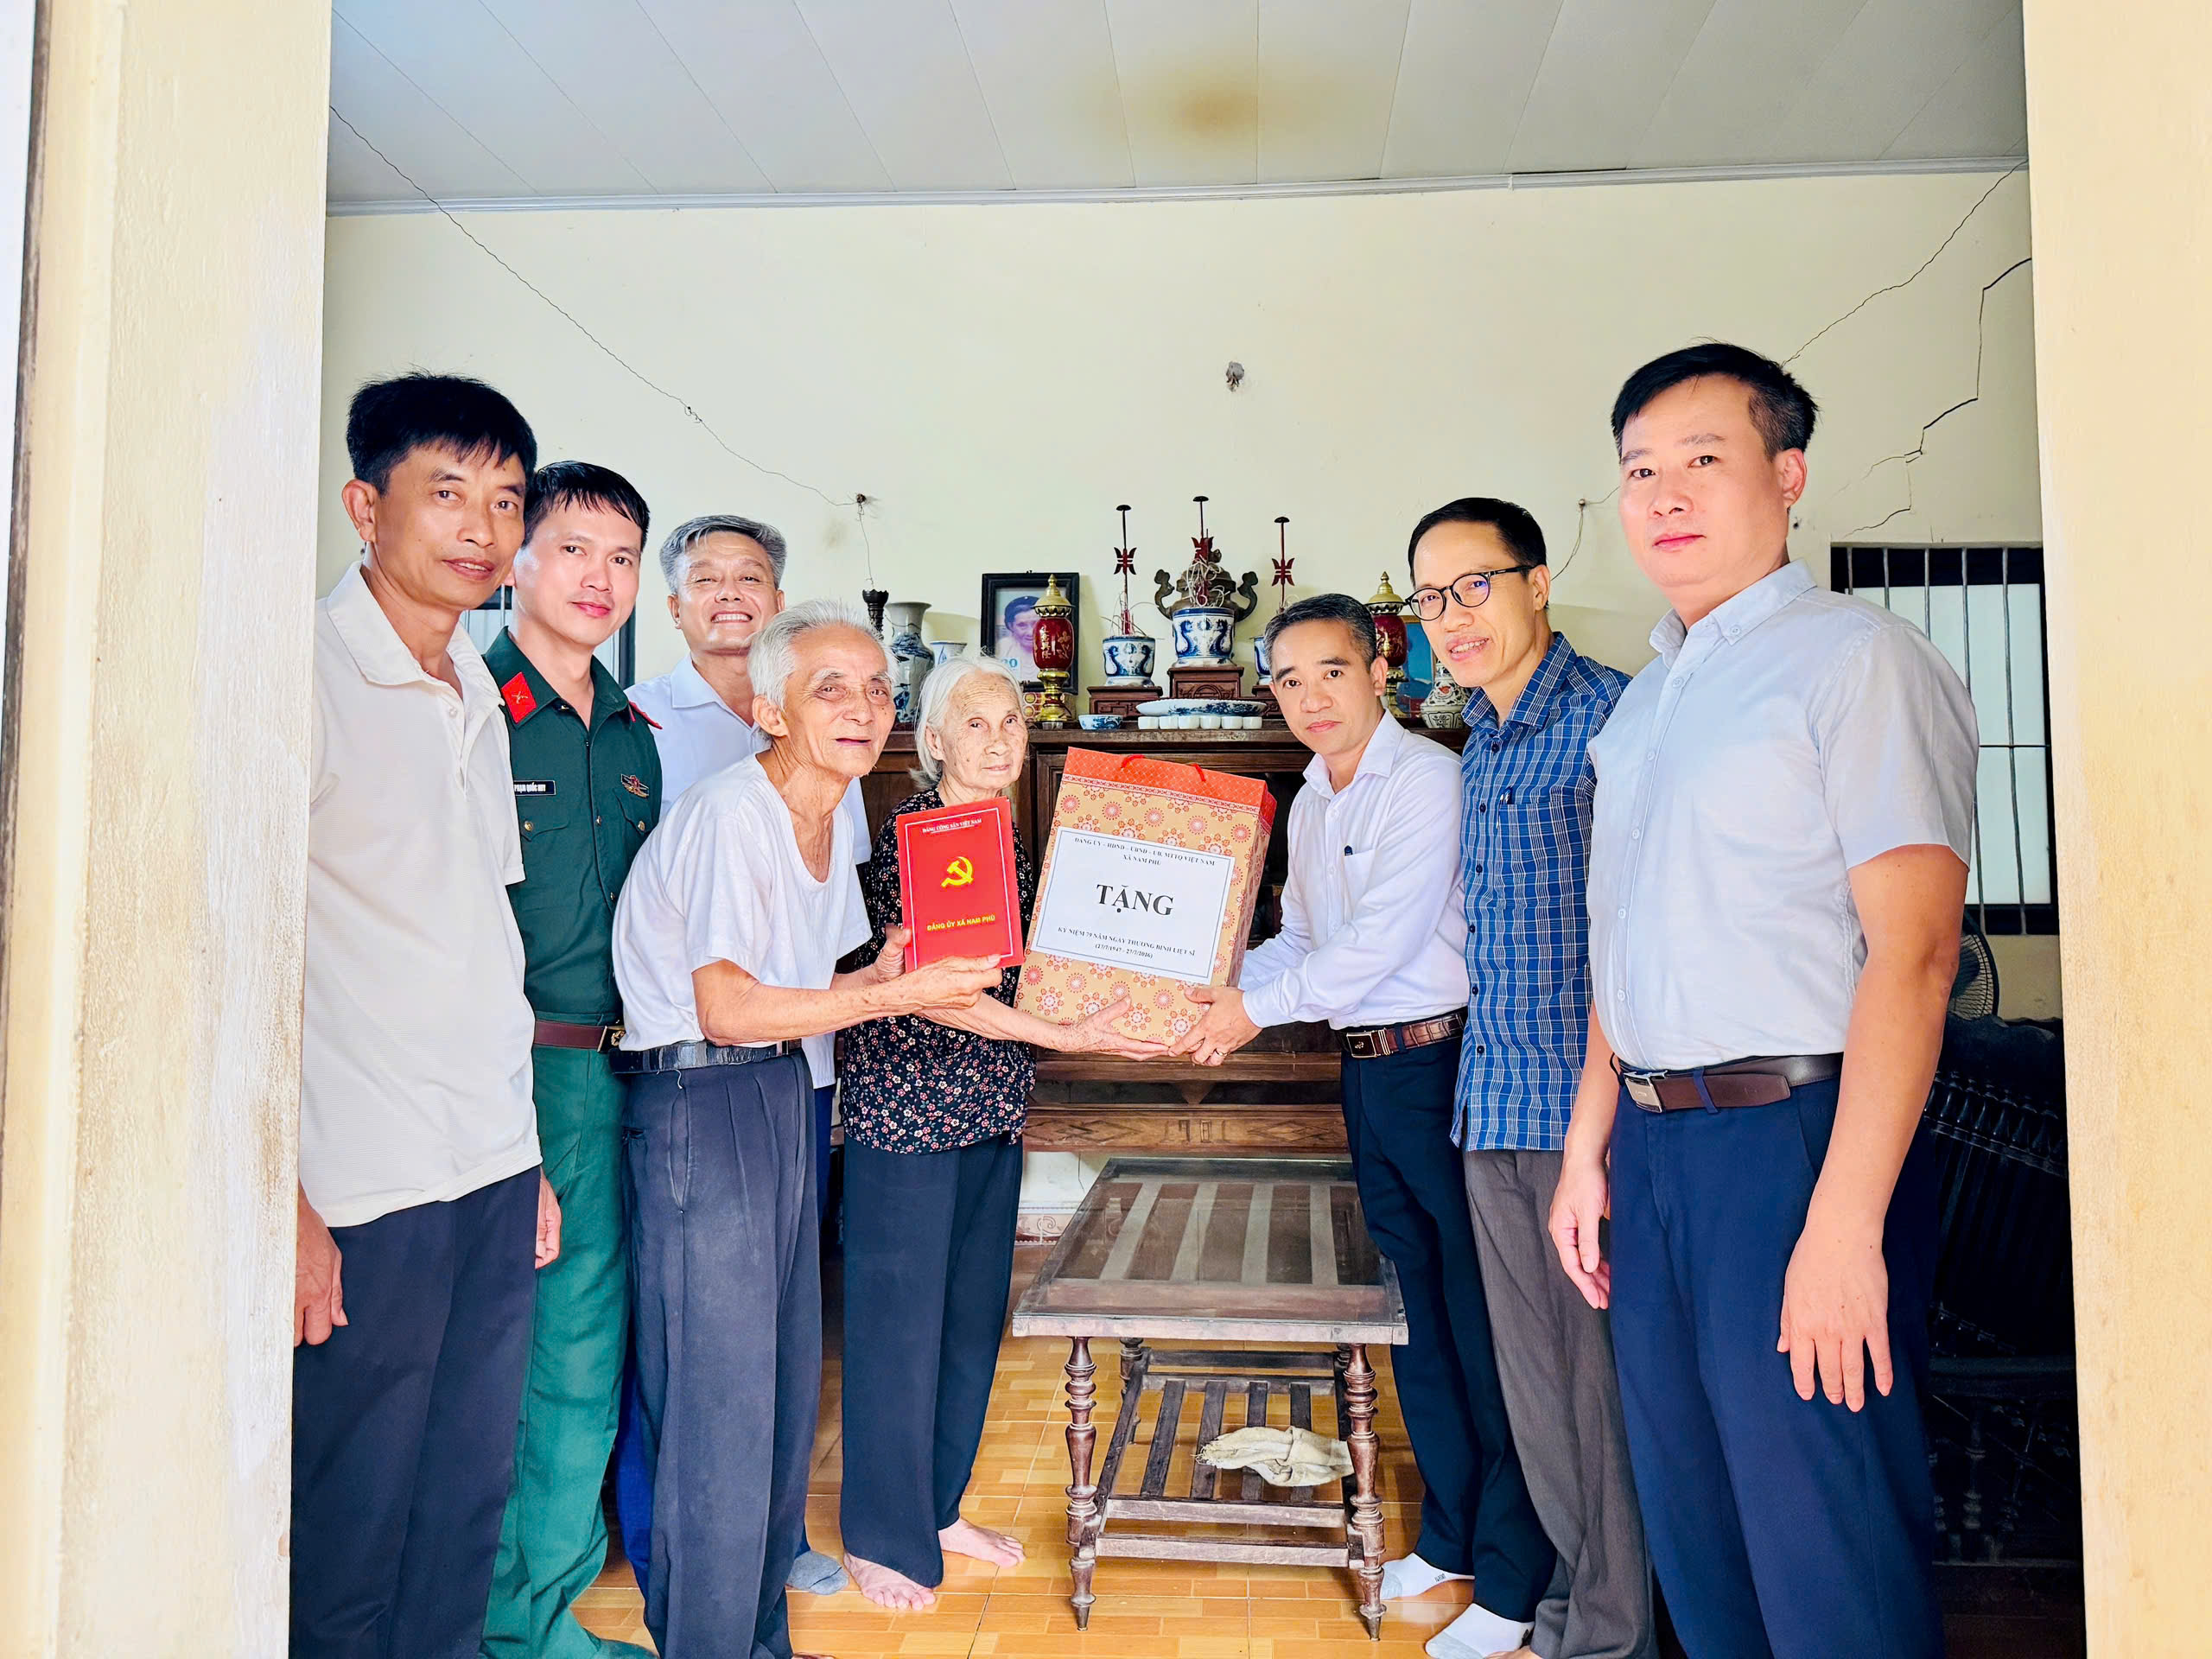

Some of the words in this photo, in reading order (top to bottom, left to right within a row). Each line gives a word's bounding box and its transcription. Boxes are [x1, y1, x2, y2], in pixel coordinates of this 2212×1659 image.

[1132, 855, 1147, 864] NAM
[1096, 884, 1174, 916] TẶNG
[926, 922, 945, 931] ĐẢNG
[957, 918, 966, 927] XÃ
[967, 917, 981, 925] NAM
